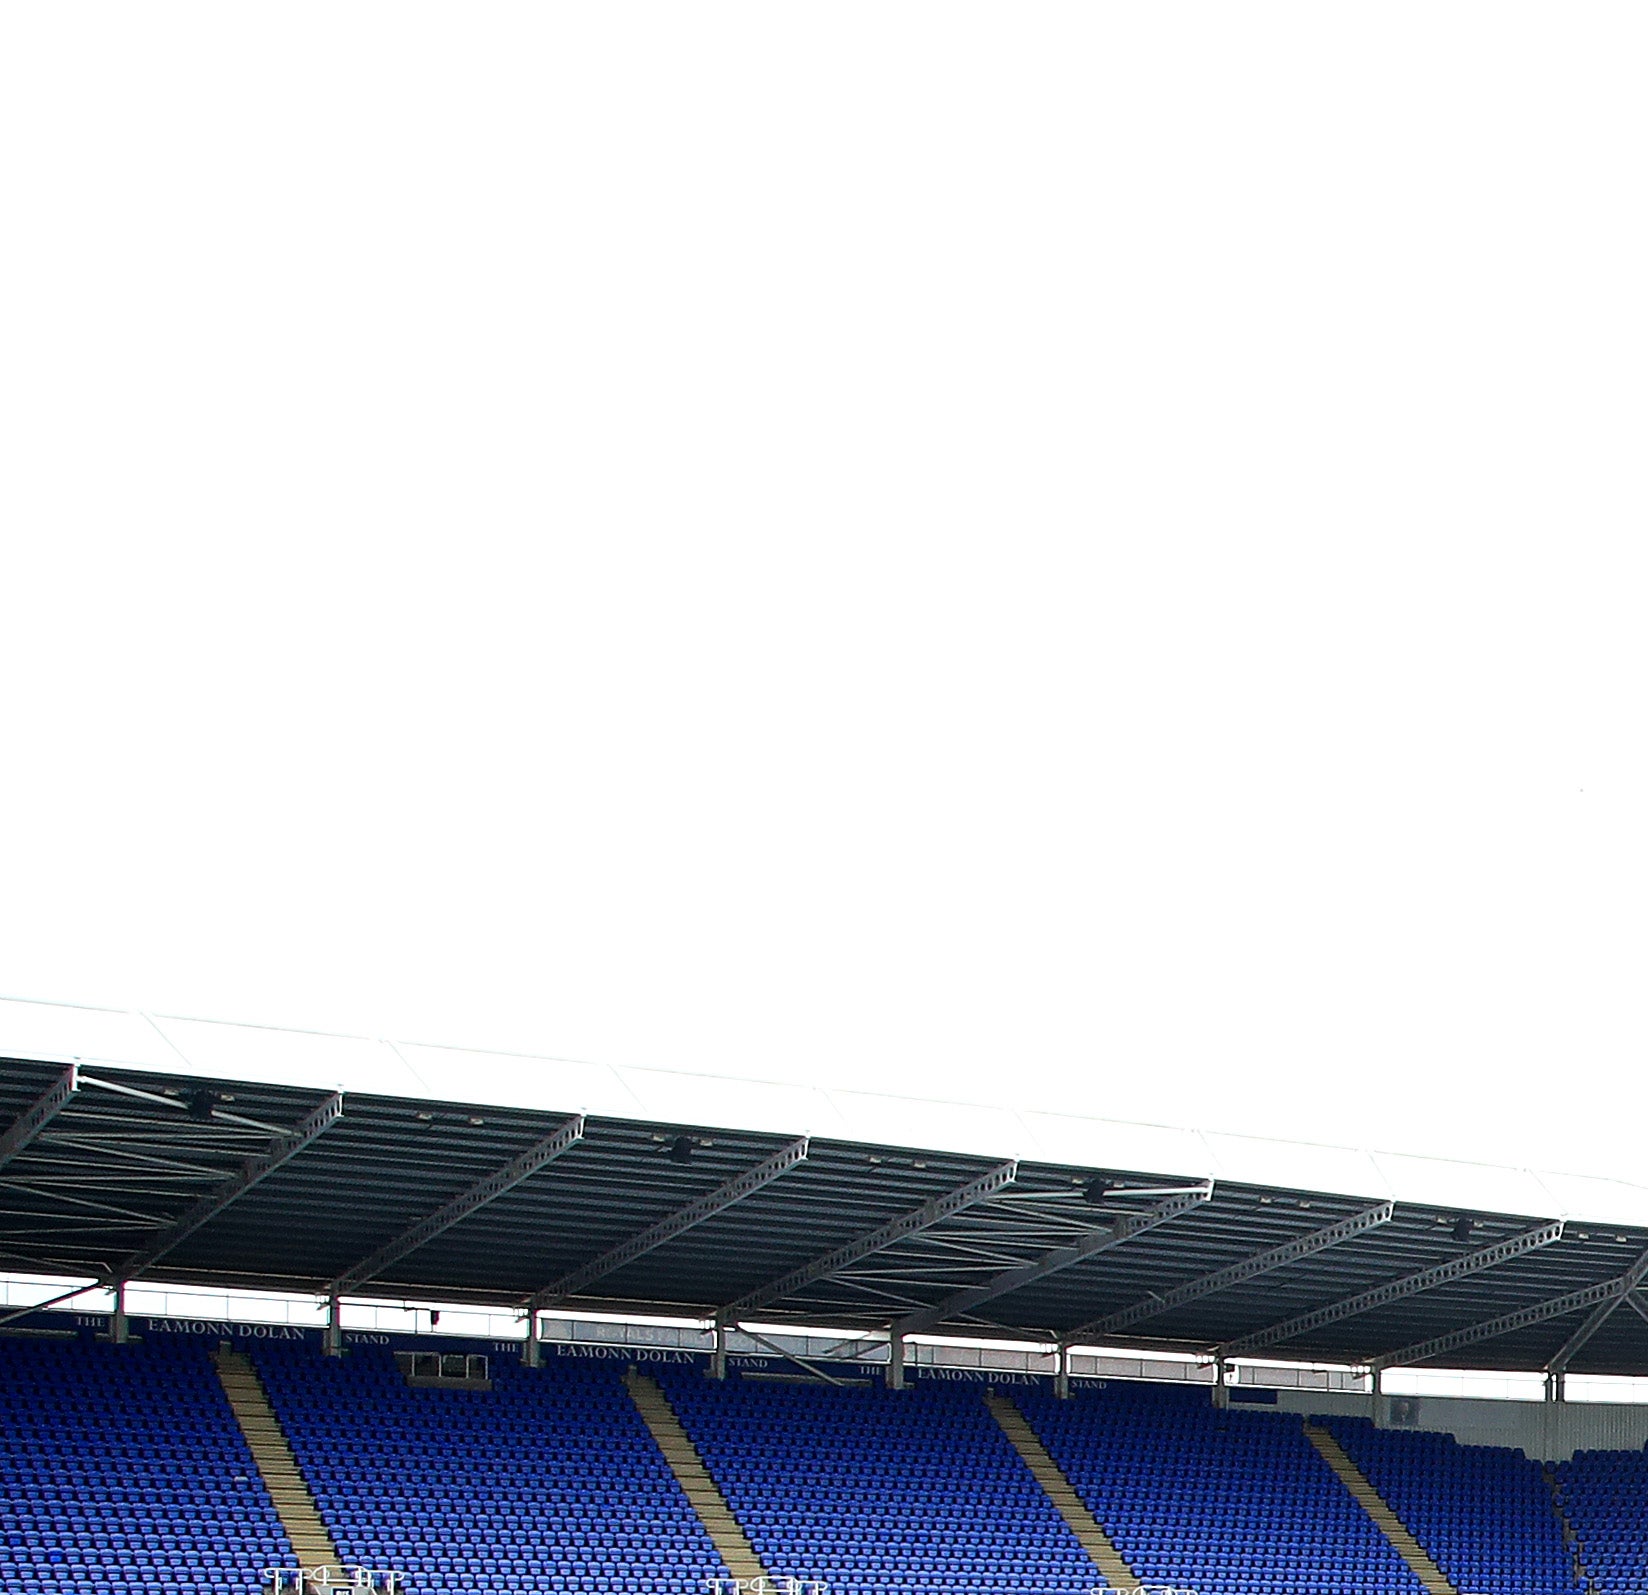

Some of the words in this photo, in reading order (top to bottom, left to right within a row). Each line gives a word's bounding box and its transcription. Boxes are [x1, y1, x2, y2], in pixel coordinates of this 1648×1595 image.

[148, 1318, 233, 1336] EAMONN
[239, 1324, 306, 1341] DOLAN
[344, 1333, 390, 1345] STAND
[557, 1344, 632, 1360] EAMONN
[636, 1350, 696, 1364] DOLAN
[727, 1357, 769, 1368] STAND
[918, 1368, 985, 1384] EAMONN
[987, 1373, 1041, 1387] DOLAN
[1071, 1380, 1107, 1391] STAND
